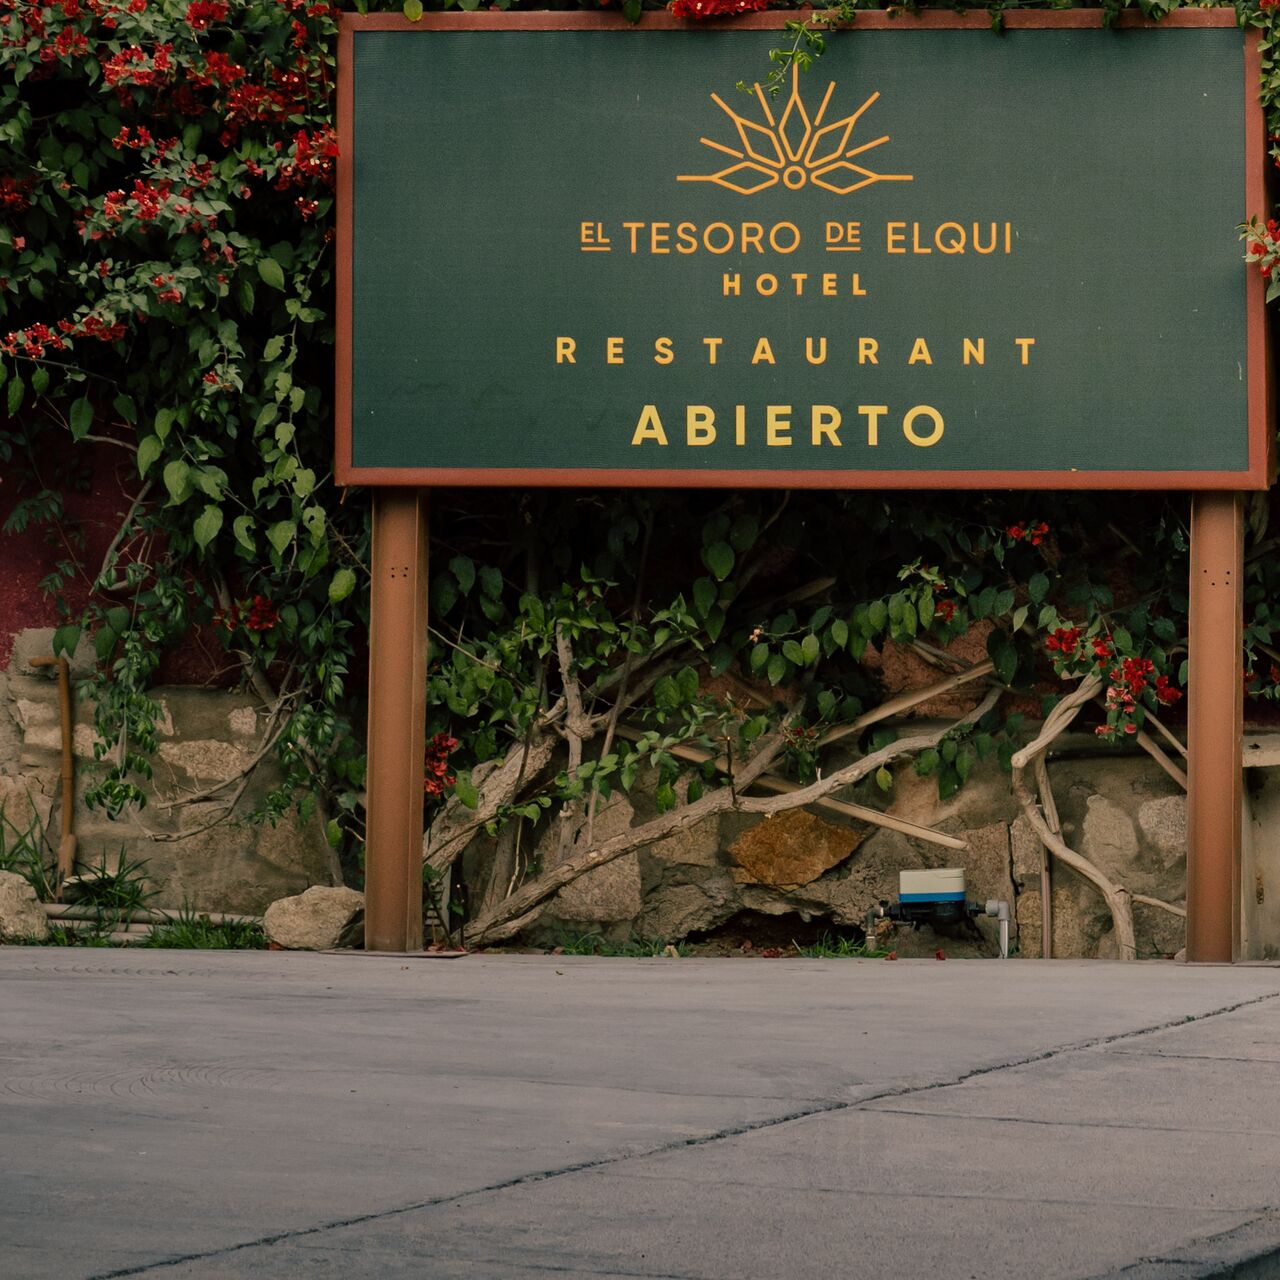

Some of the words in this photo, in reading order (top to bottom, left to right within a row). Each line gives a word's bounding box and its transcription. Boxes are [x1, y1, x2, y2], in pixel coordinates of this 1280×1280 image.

[580, 221, 611, 244] EL
[622, 220, 801, 255] TESORO
[825, 221, 862, 244] DE
[886, 221, 1012, 255] ELQUI
[722, 272, 867, 297] HOTEL
[555, 336, 1036, 366] RESTAURANT
[630, 404, 946, 448] ABIERTO
